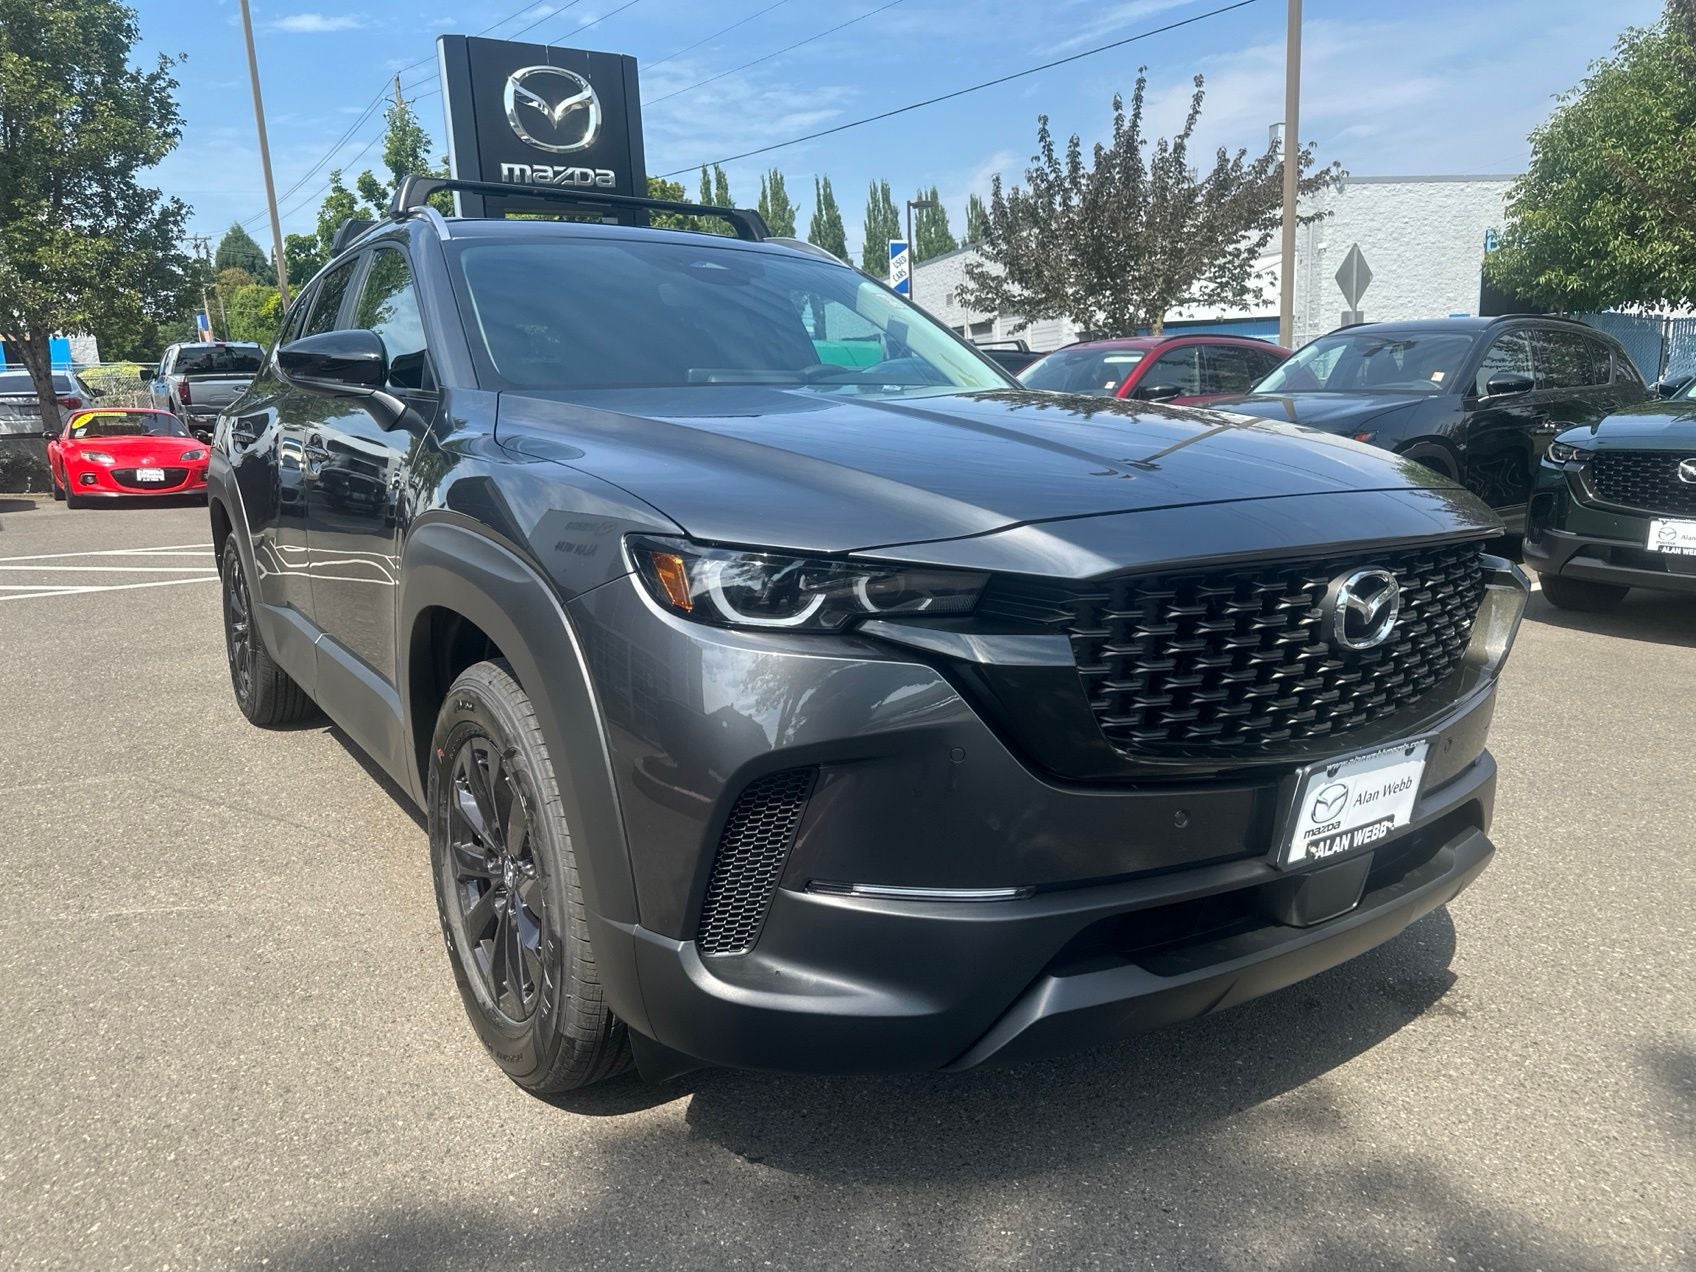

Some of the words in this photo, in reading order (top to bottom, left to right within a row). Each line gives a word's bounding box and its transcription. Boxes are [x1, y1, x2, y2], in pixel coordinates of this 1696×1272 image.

[893, 255, 907, 269] USED
[893, 268, 908, 282] CARS
[1661, 546, 1681, 555] ALAN
[1353, 790, 1380, 808] Alan
[1383, 776, 1413, 797] Webb
[1303, 820, 1341, 840] mazda
[1314, 832, 1351, 860] ALAN
[1353, 821, 1388, 847] WEBB
